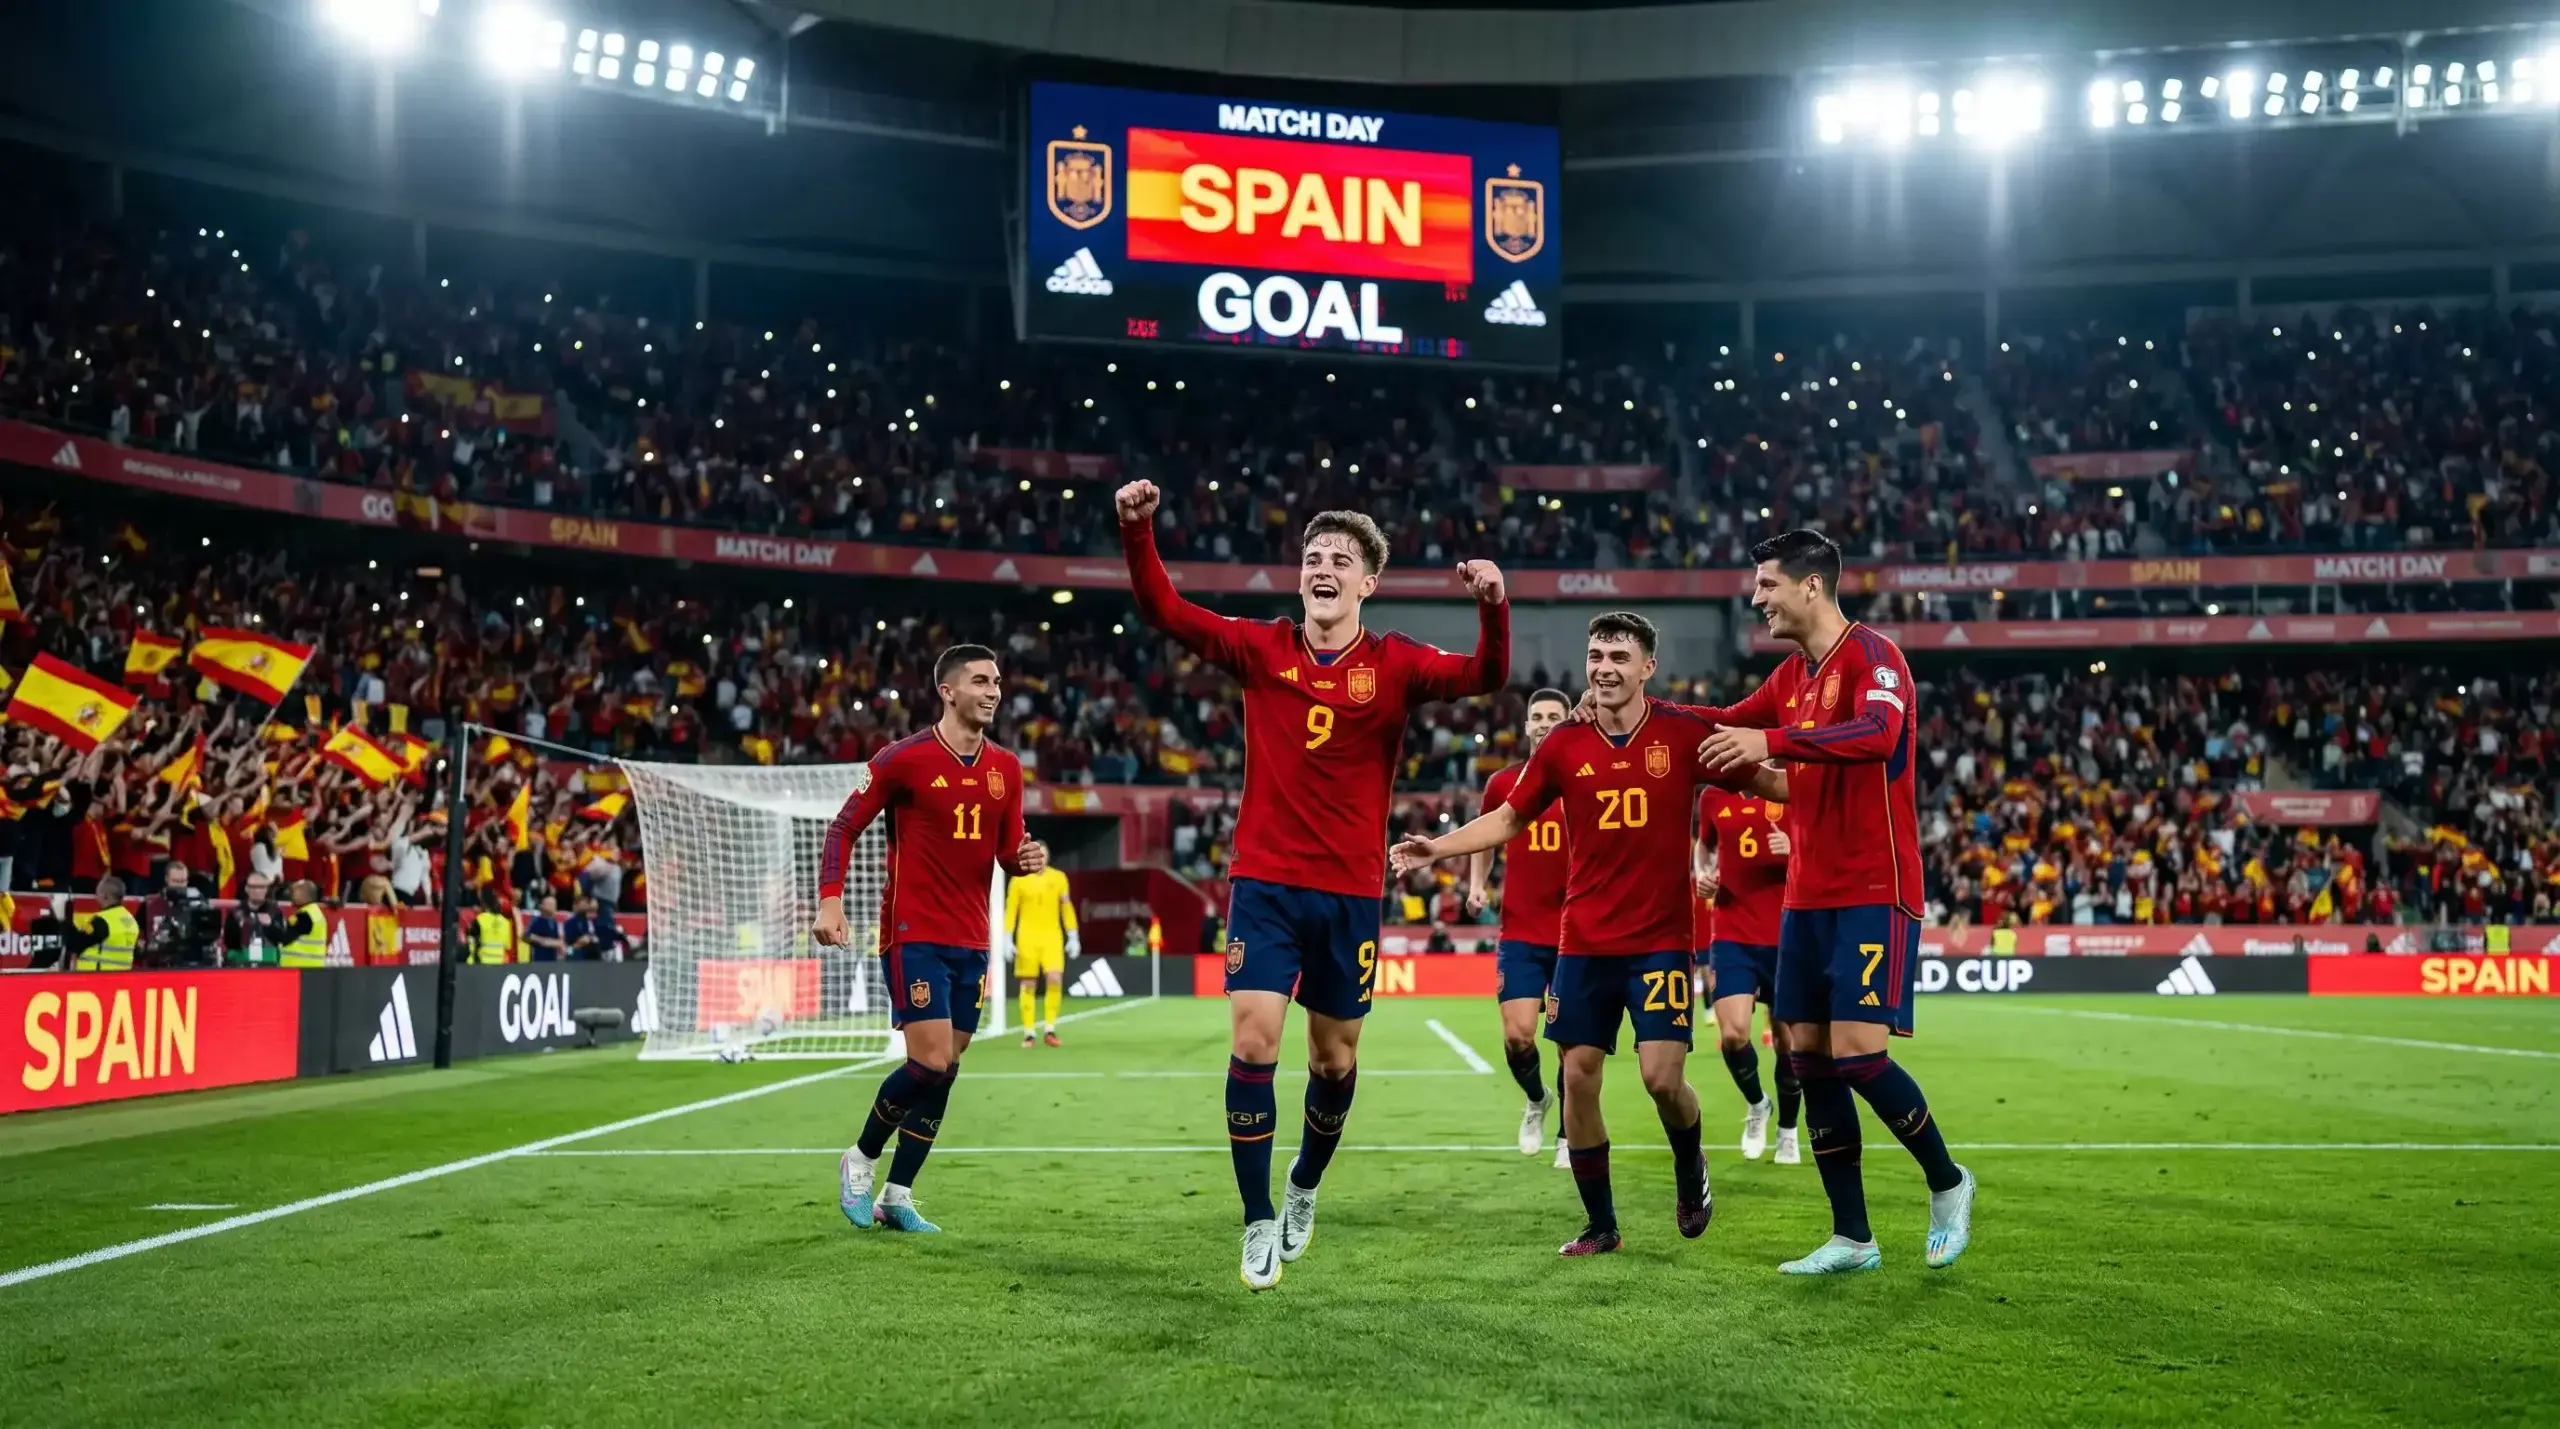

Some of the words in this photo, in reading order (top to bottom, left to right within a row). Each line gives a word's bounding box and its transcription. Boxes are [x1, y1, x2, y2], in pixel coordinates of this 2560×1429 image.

[1218, 104, 1322, 138] MATCH
[1326, 112, 1385, 143] DAY
[1179, 163, 1424, 247] SPAIN
[1197, 271, 1404, 344] GOAL
[549, 516, 619, 548] SPAIN
[715, 535, 791, 566] MATCH
[794, 539, 836, 568] DAY
[2314, 555, 2395, 579] MATCH
[2400, 554, 2447, 578] DAY
[1558, 573, 1617, 595] GOAL
[2130, 560, 2201, 584] SPAIN
[1305, 704, 1335, 750] 9
[953, 803, 982, 840] 11
[1596, 787, 1648, 830] 20
[1527, 820, 1561, 851] 10
[1739, 827, 1758, 858] 6
[1358, 939, 1376, 986] 9
[1859, 943, 1884, 986] 7
[1955, 958, 2034, 992] CUP
[2420, 957, 2550, 994] SPAIN
[499, 972, 577, 1043] GOAL
[1642, 969, 1690, 1012] 20
[22, 986, 198, 1092] SPAIN
